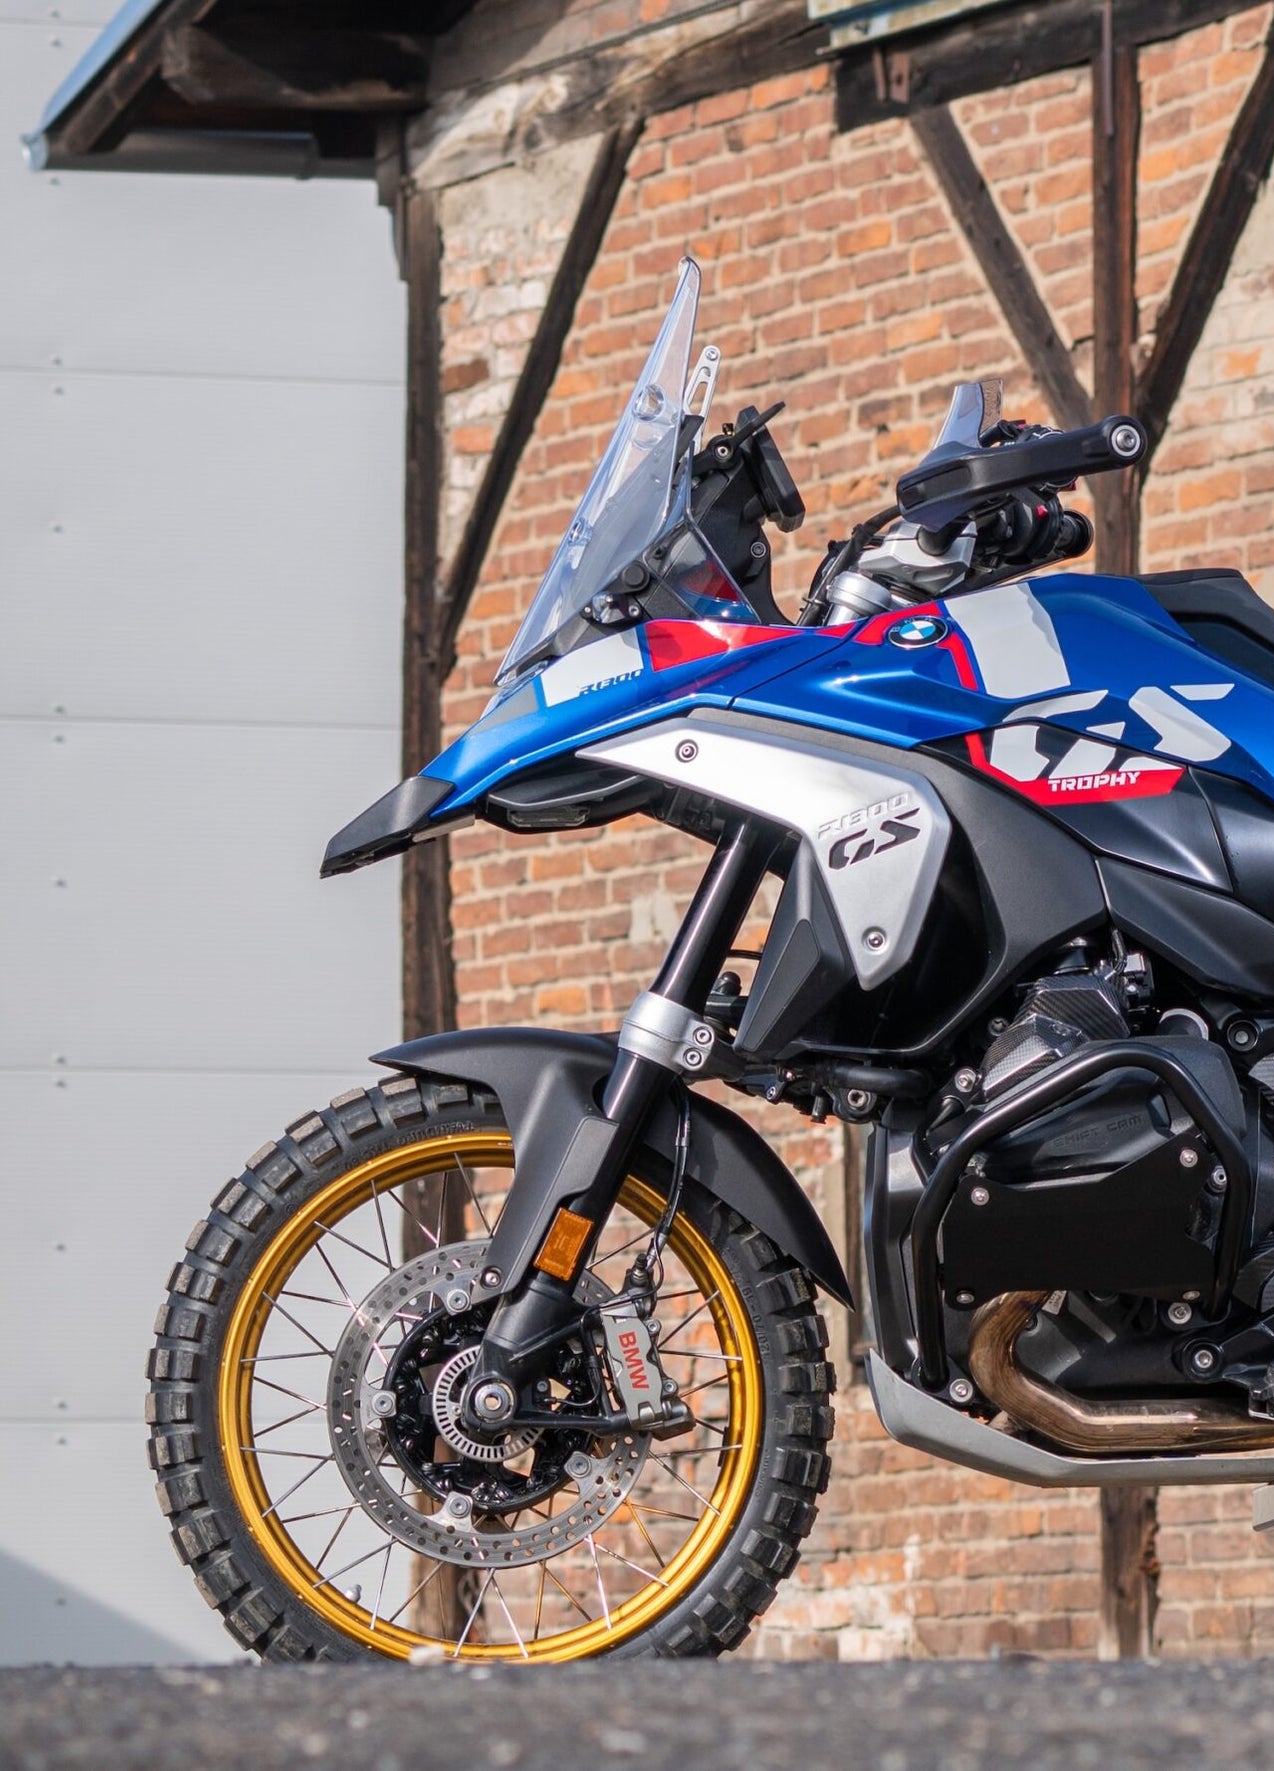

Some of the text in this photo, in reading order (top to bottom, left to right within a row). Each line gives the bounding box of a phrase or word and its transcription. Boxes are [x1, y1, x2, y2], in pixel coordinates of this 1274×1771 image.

[990, 683, 1235, 782] GS
[1047, 771, 1141, 792] TROPHY
[817, 791, 911, 840] R1300
[828, 807, 921, 870] GS
[618, 1331, 650, 1389] BMW
